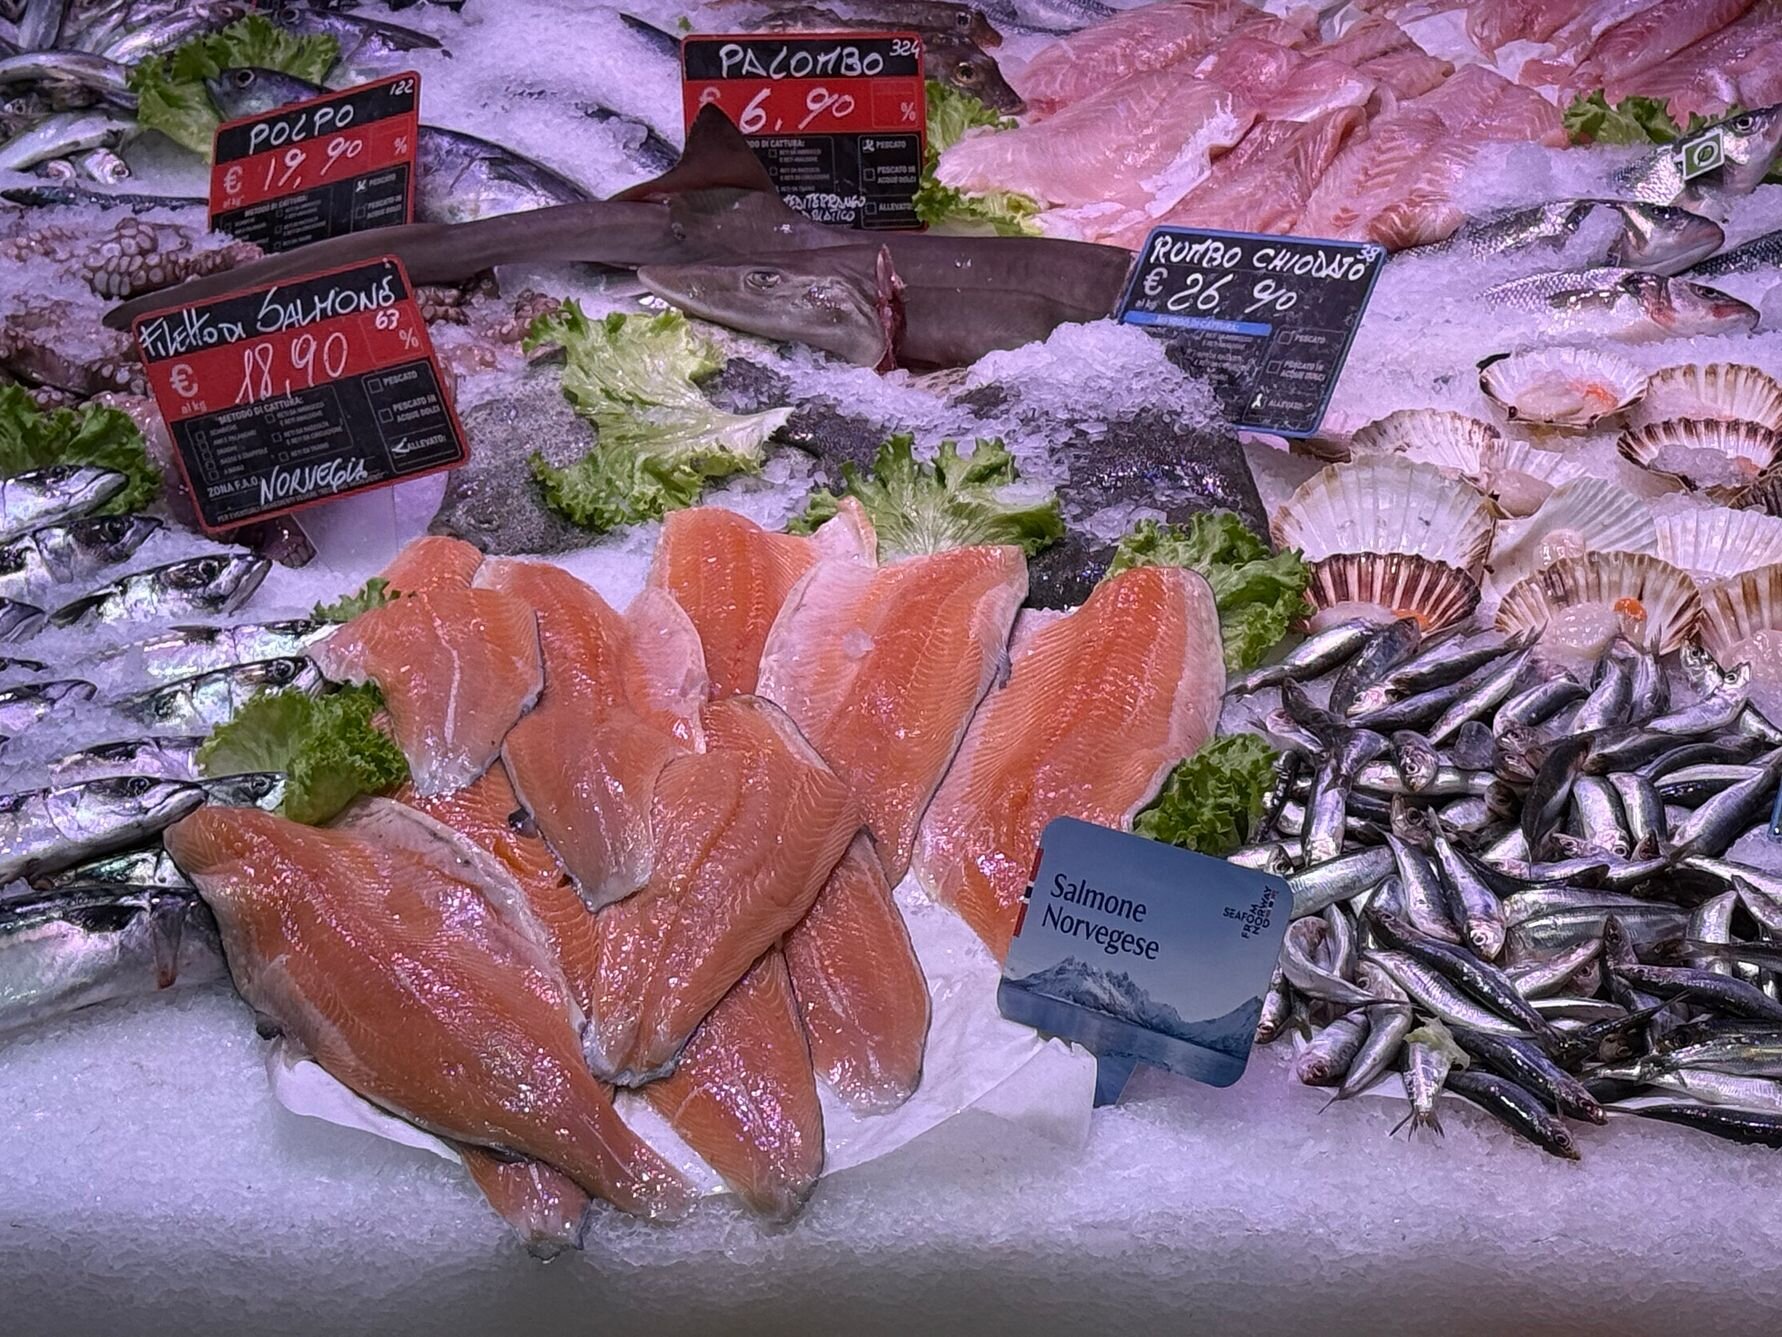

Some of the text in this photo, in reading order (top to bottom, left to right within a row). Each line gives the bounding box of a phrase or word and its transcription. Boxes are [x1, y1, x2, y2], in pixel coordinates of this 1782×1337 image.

[718, 43, 884, 80] PALOMBO
[888, 38, 921, 60] 324
[389, 78, 414, 96] 122
[249, 104, 355, 155] POLPO
[738, 87, 855, 135] 6,90
[223, 136, 363, 195] € 19,90
[1252, 247, 1366, 282] CHIODATO
[1143, 267, 1298, 315] € 26,90
[375, 308, 400, 330] 63
[399, 327, 420, 350] %
[168, 330, 348, 406] € 18,90
[381, 370, 418, 387] PESCATO
[392, 396, 428, 413] PESCATO
[207, 479, 235, 498] ZONA
[260, 456, 369, 506] NORVEGIA
[1050, 872, 1148, 923] Salmone
[1041, 903, 1160, 961] Norvegese
[1222, 906, 1271, 929] SEAFOOD
